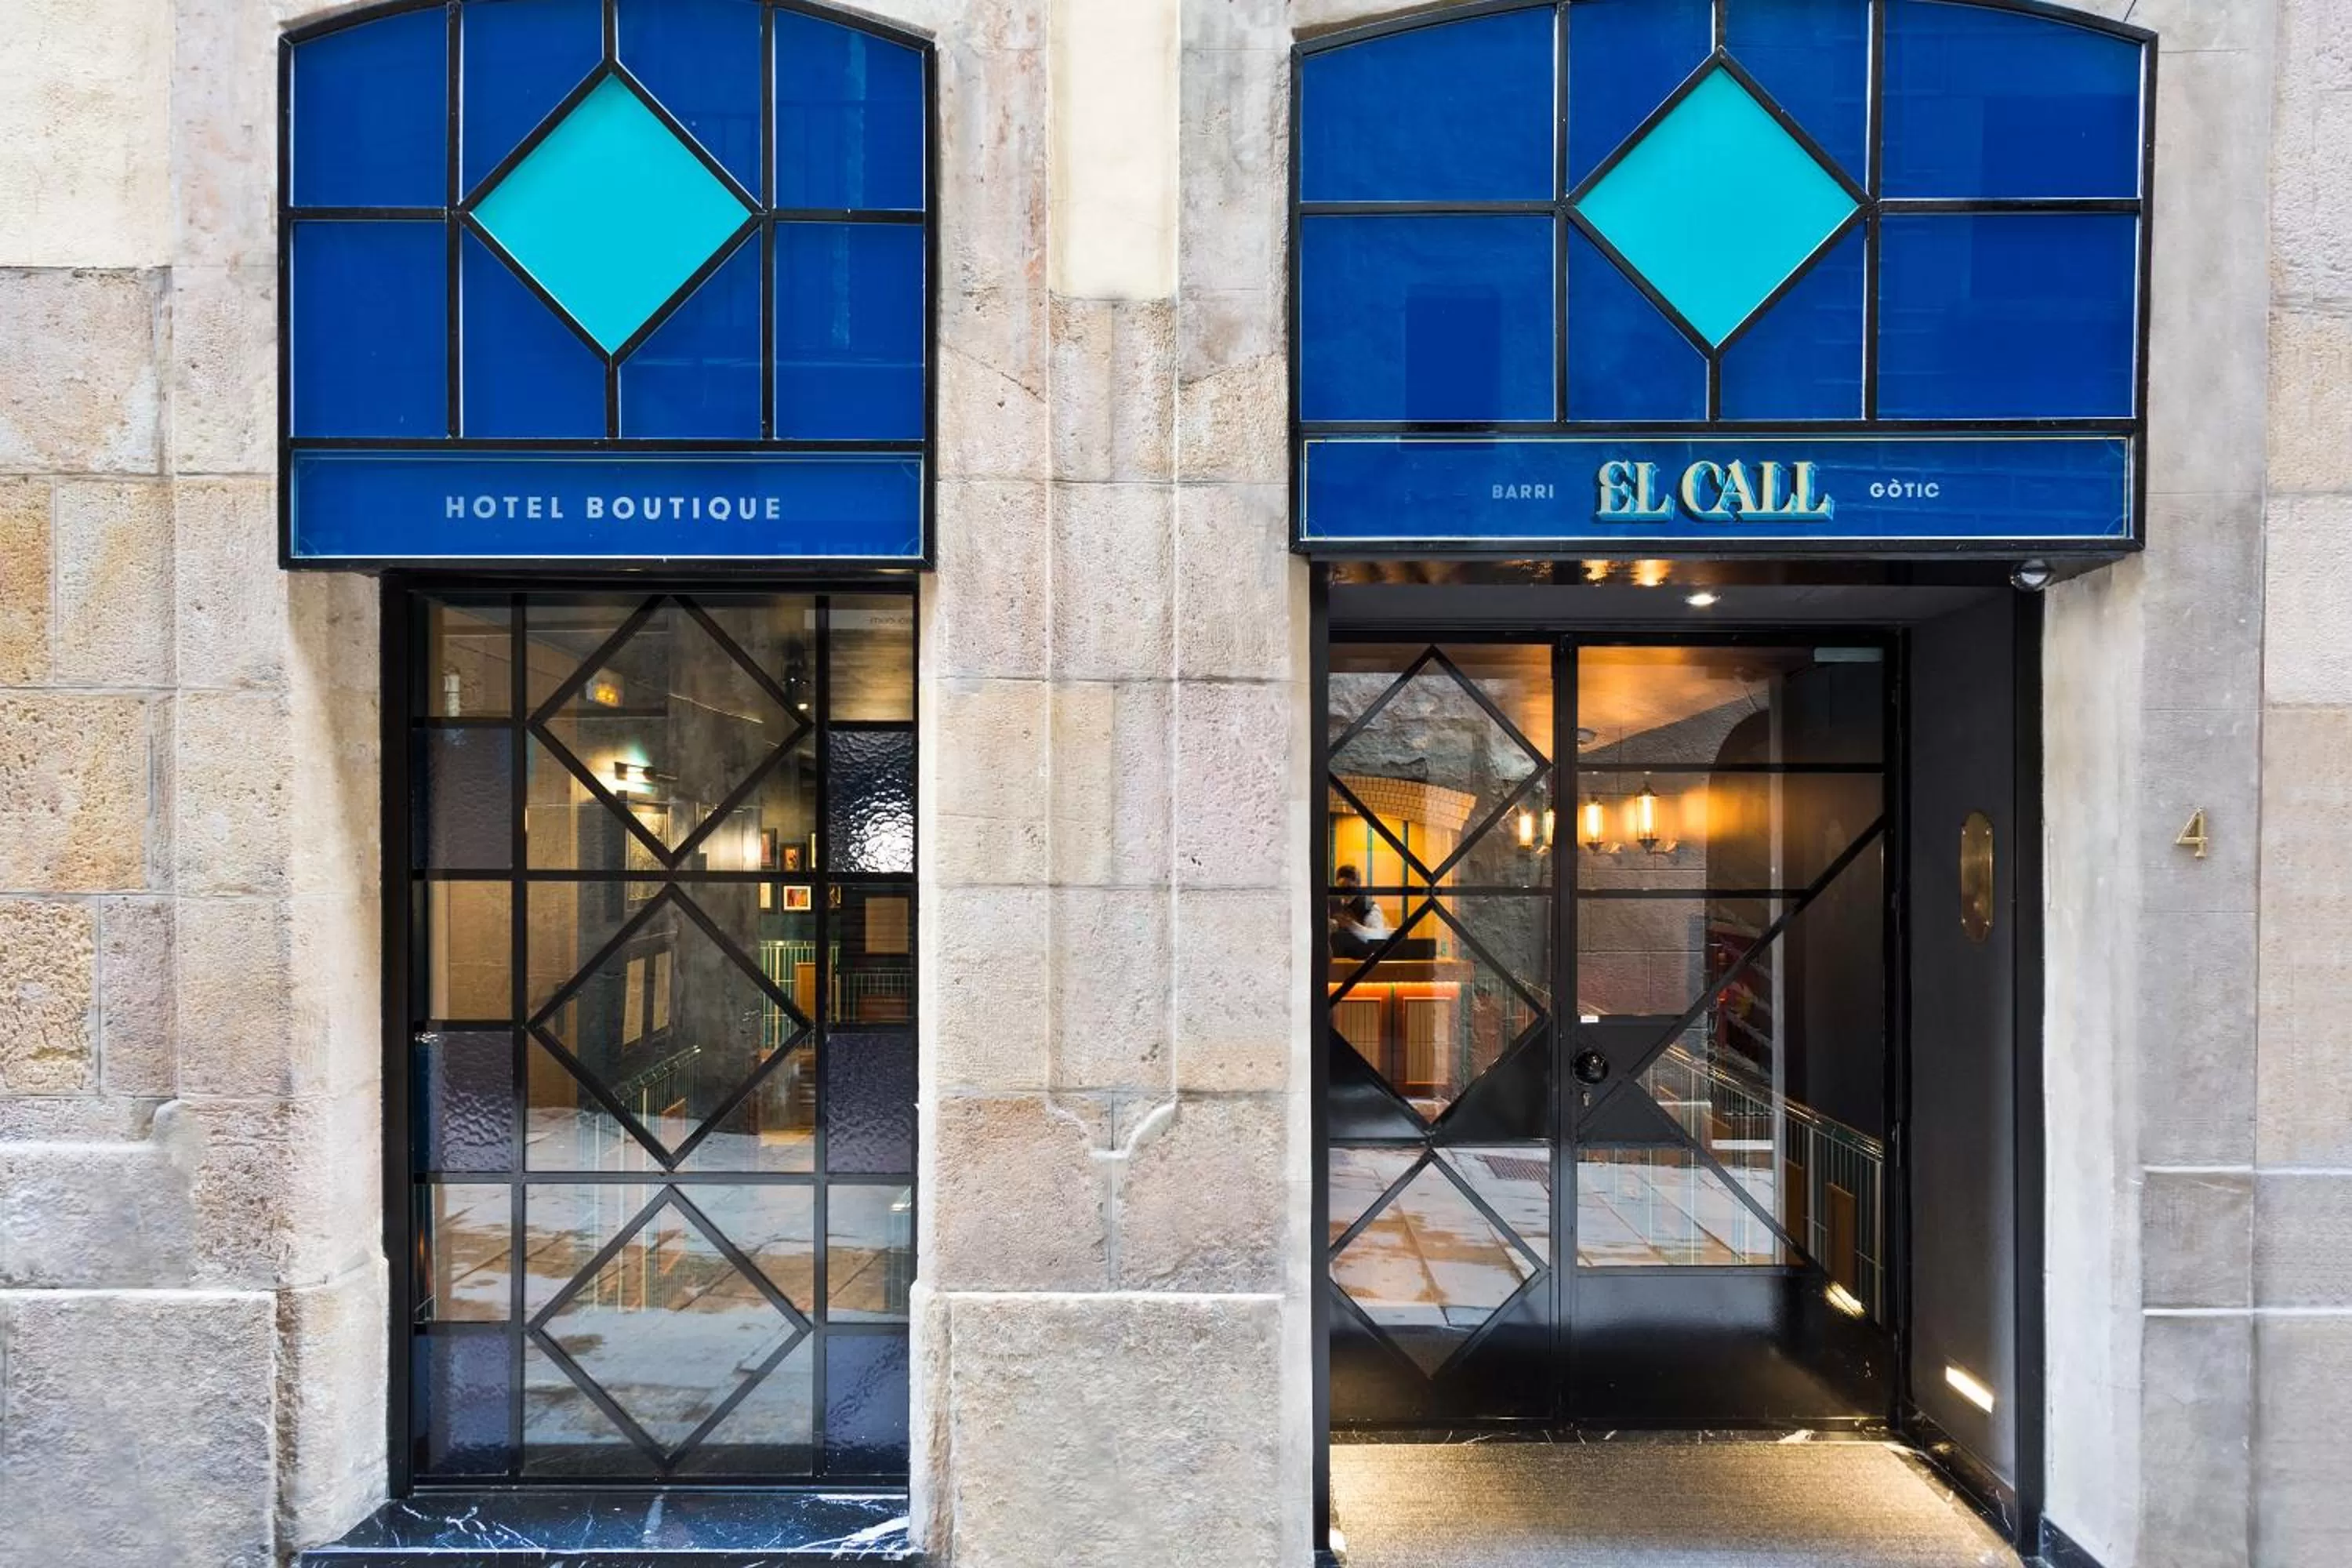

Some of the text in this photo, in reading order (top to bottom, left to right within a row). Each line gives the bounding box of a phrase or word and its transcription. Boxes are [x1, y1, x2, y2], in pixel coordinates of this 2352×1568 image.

[445, 495, 781, 521] HOTEL BOUTIQUE
[1492, 458, 1940, 521] BARRI EL CALL GÒTIC
[2175, 805, 2209, 858] 4
